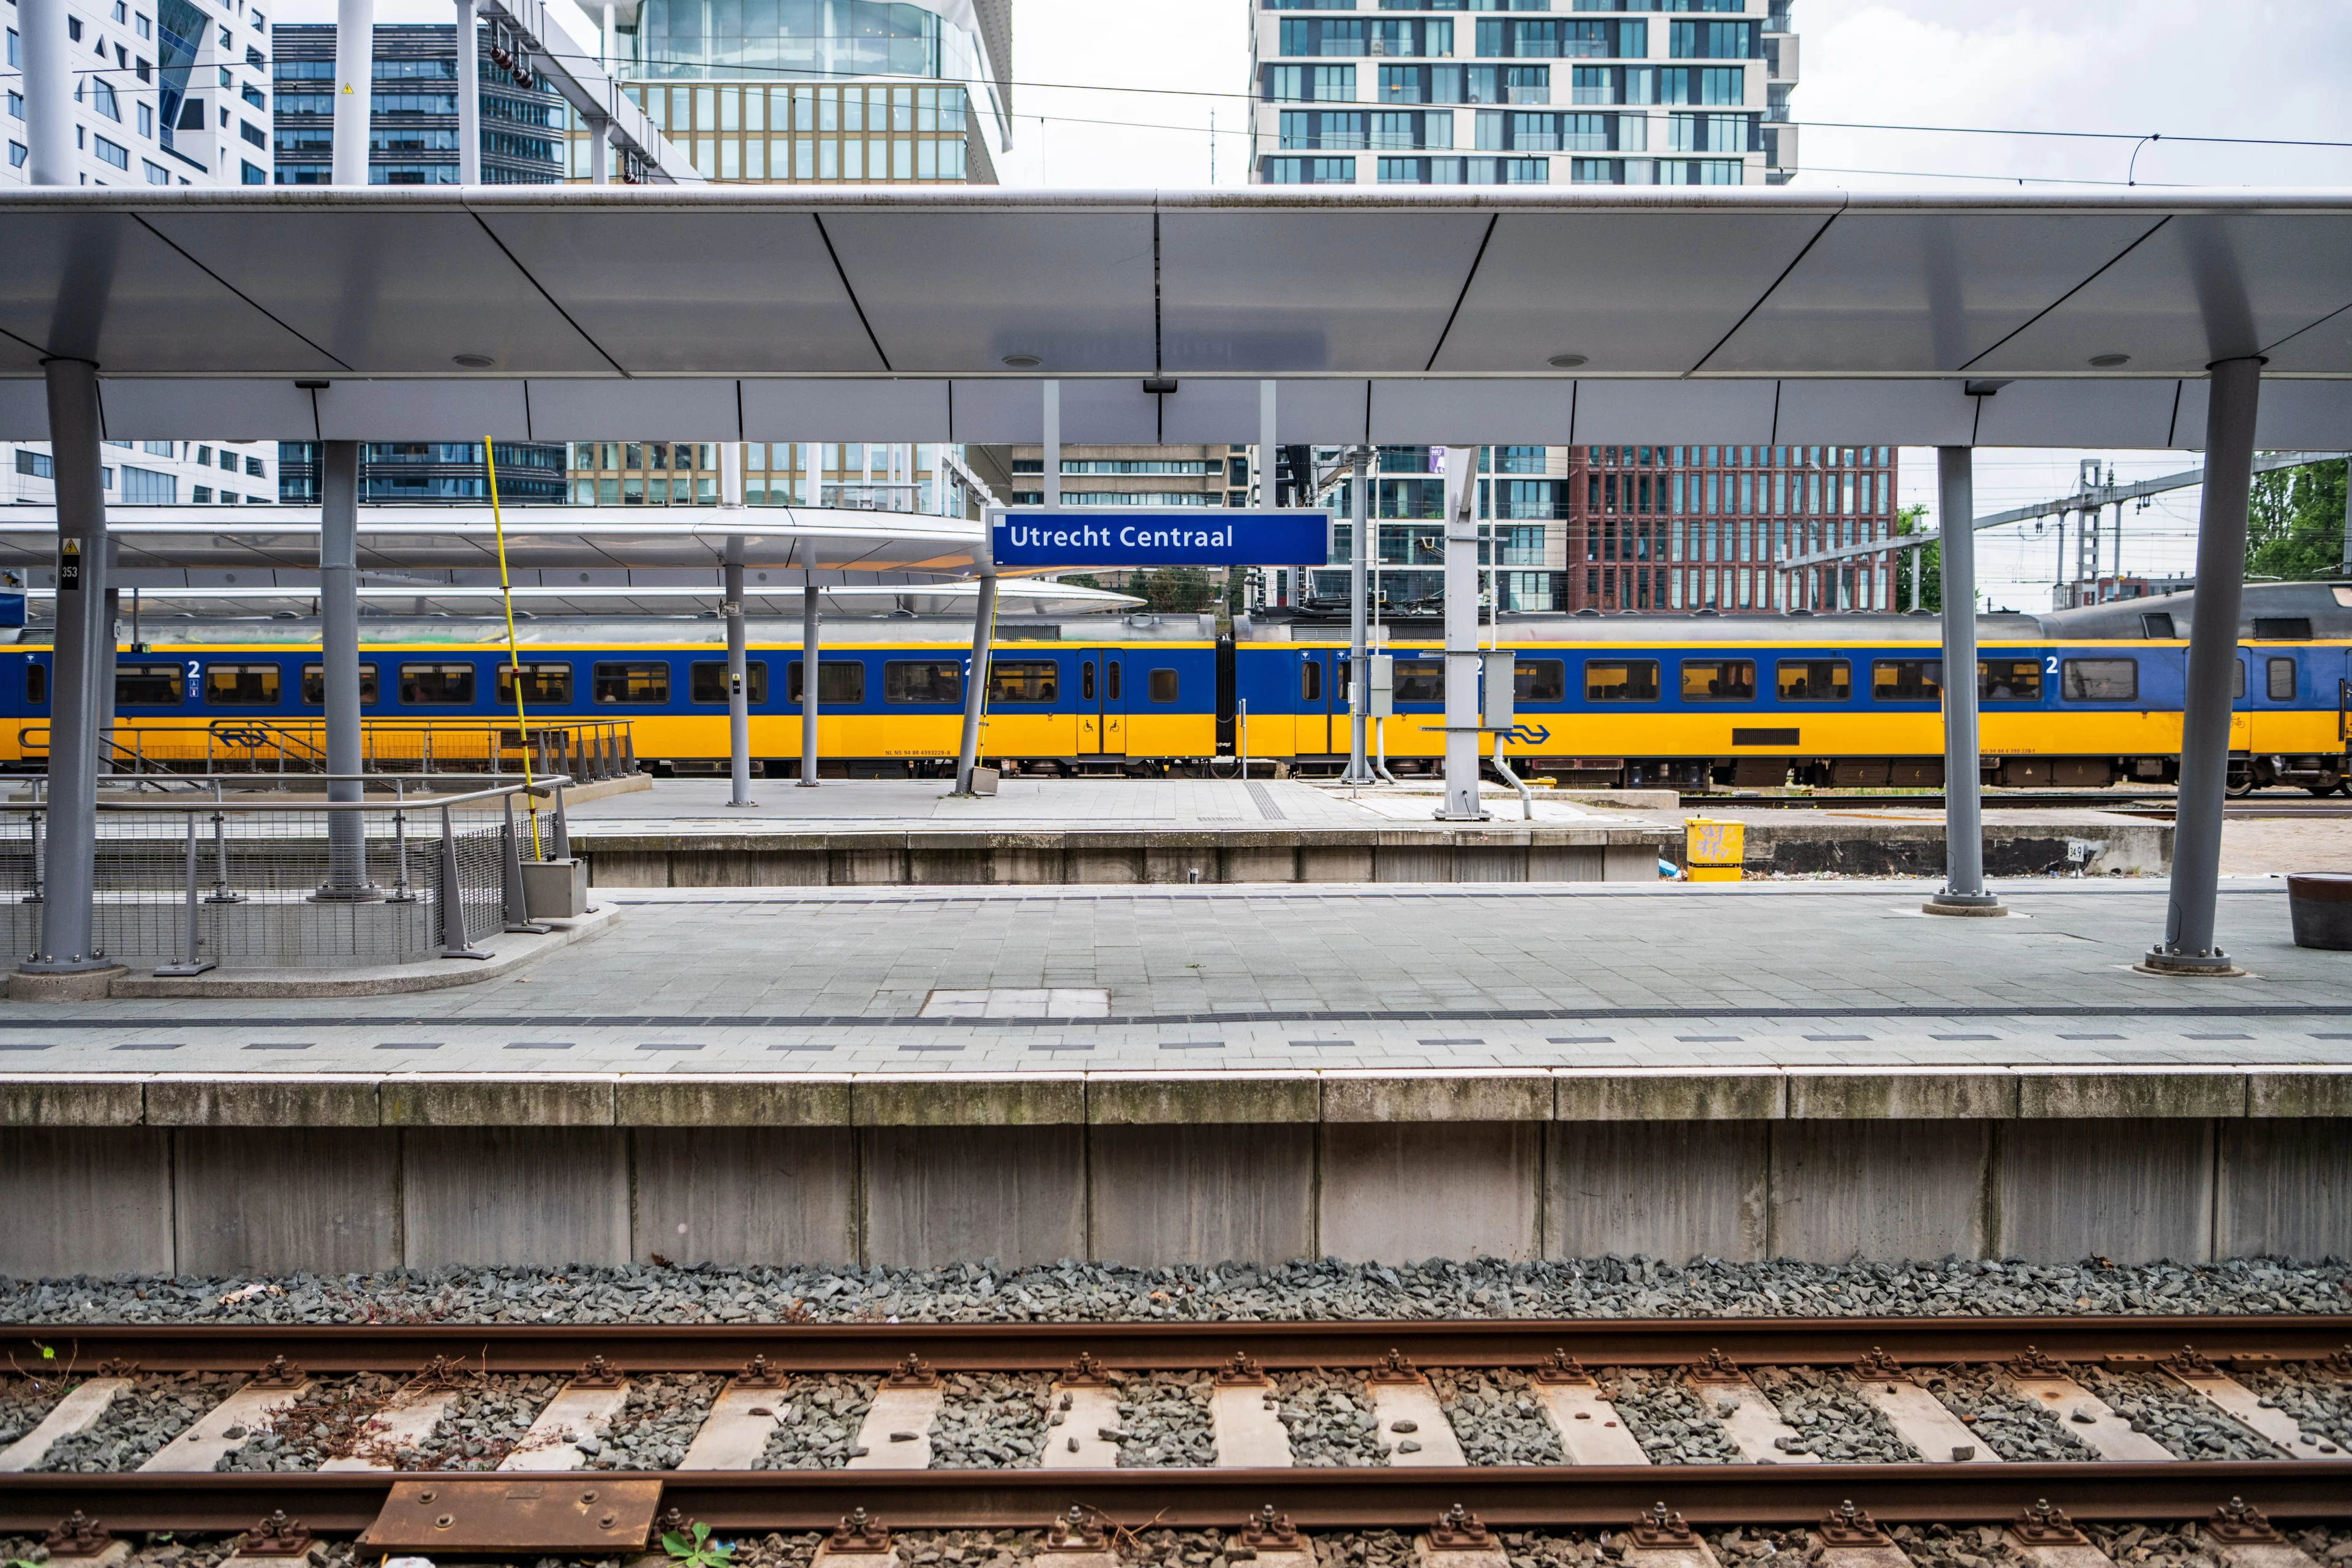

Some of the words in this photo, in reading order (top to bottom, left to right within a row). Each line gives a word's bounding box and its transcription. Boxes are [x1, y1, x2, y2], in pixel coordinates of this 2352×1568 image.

[1011, 525, 1110, 547] Utrecht
[1120, 525, 1232, 547] Centraal
[62, 566, 78, 578] 353
[187, 660, 200, 678] 2
[2046, 656, 2058, 674] 2
[1437, 834, 1452, 843] 354
[2070, 846, 2081, 858] 34.9
